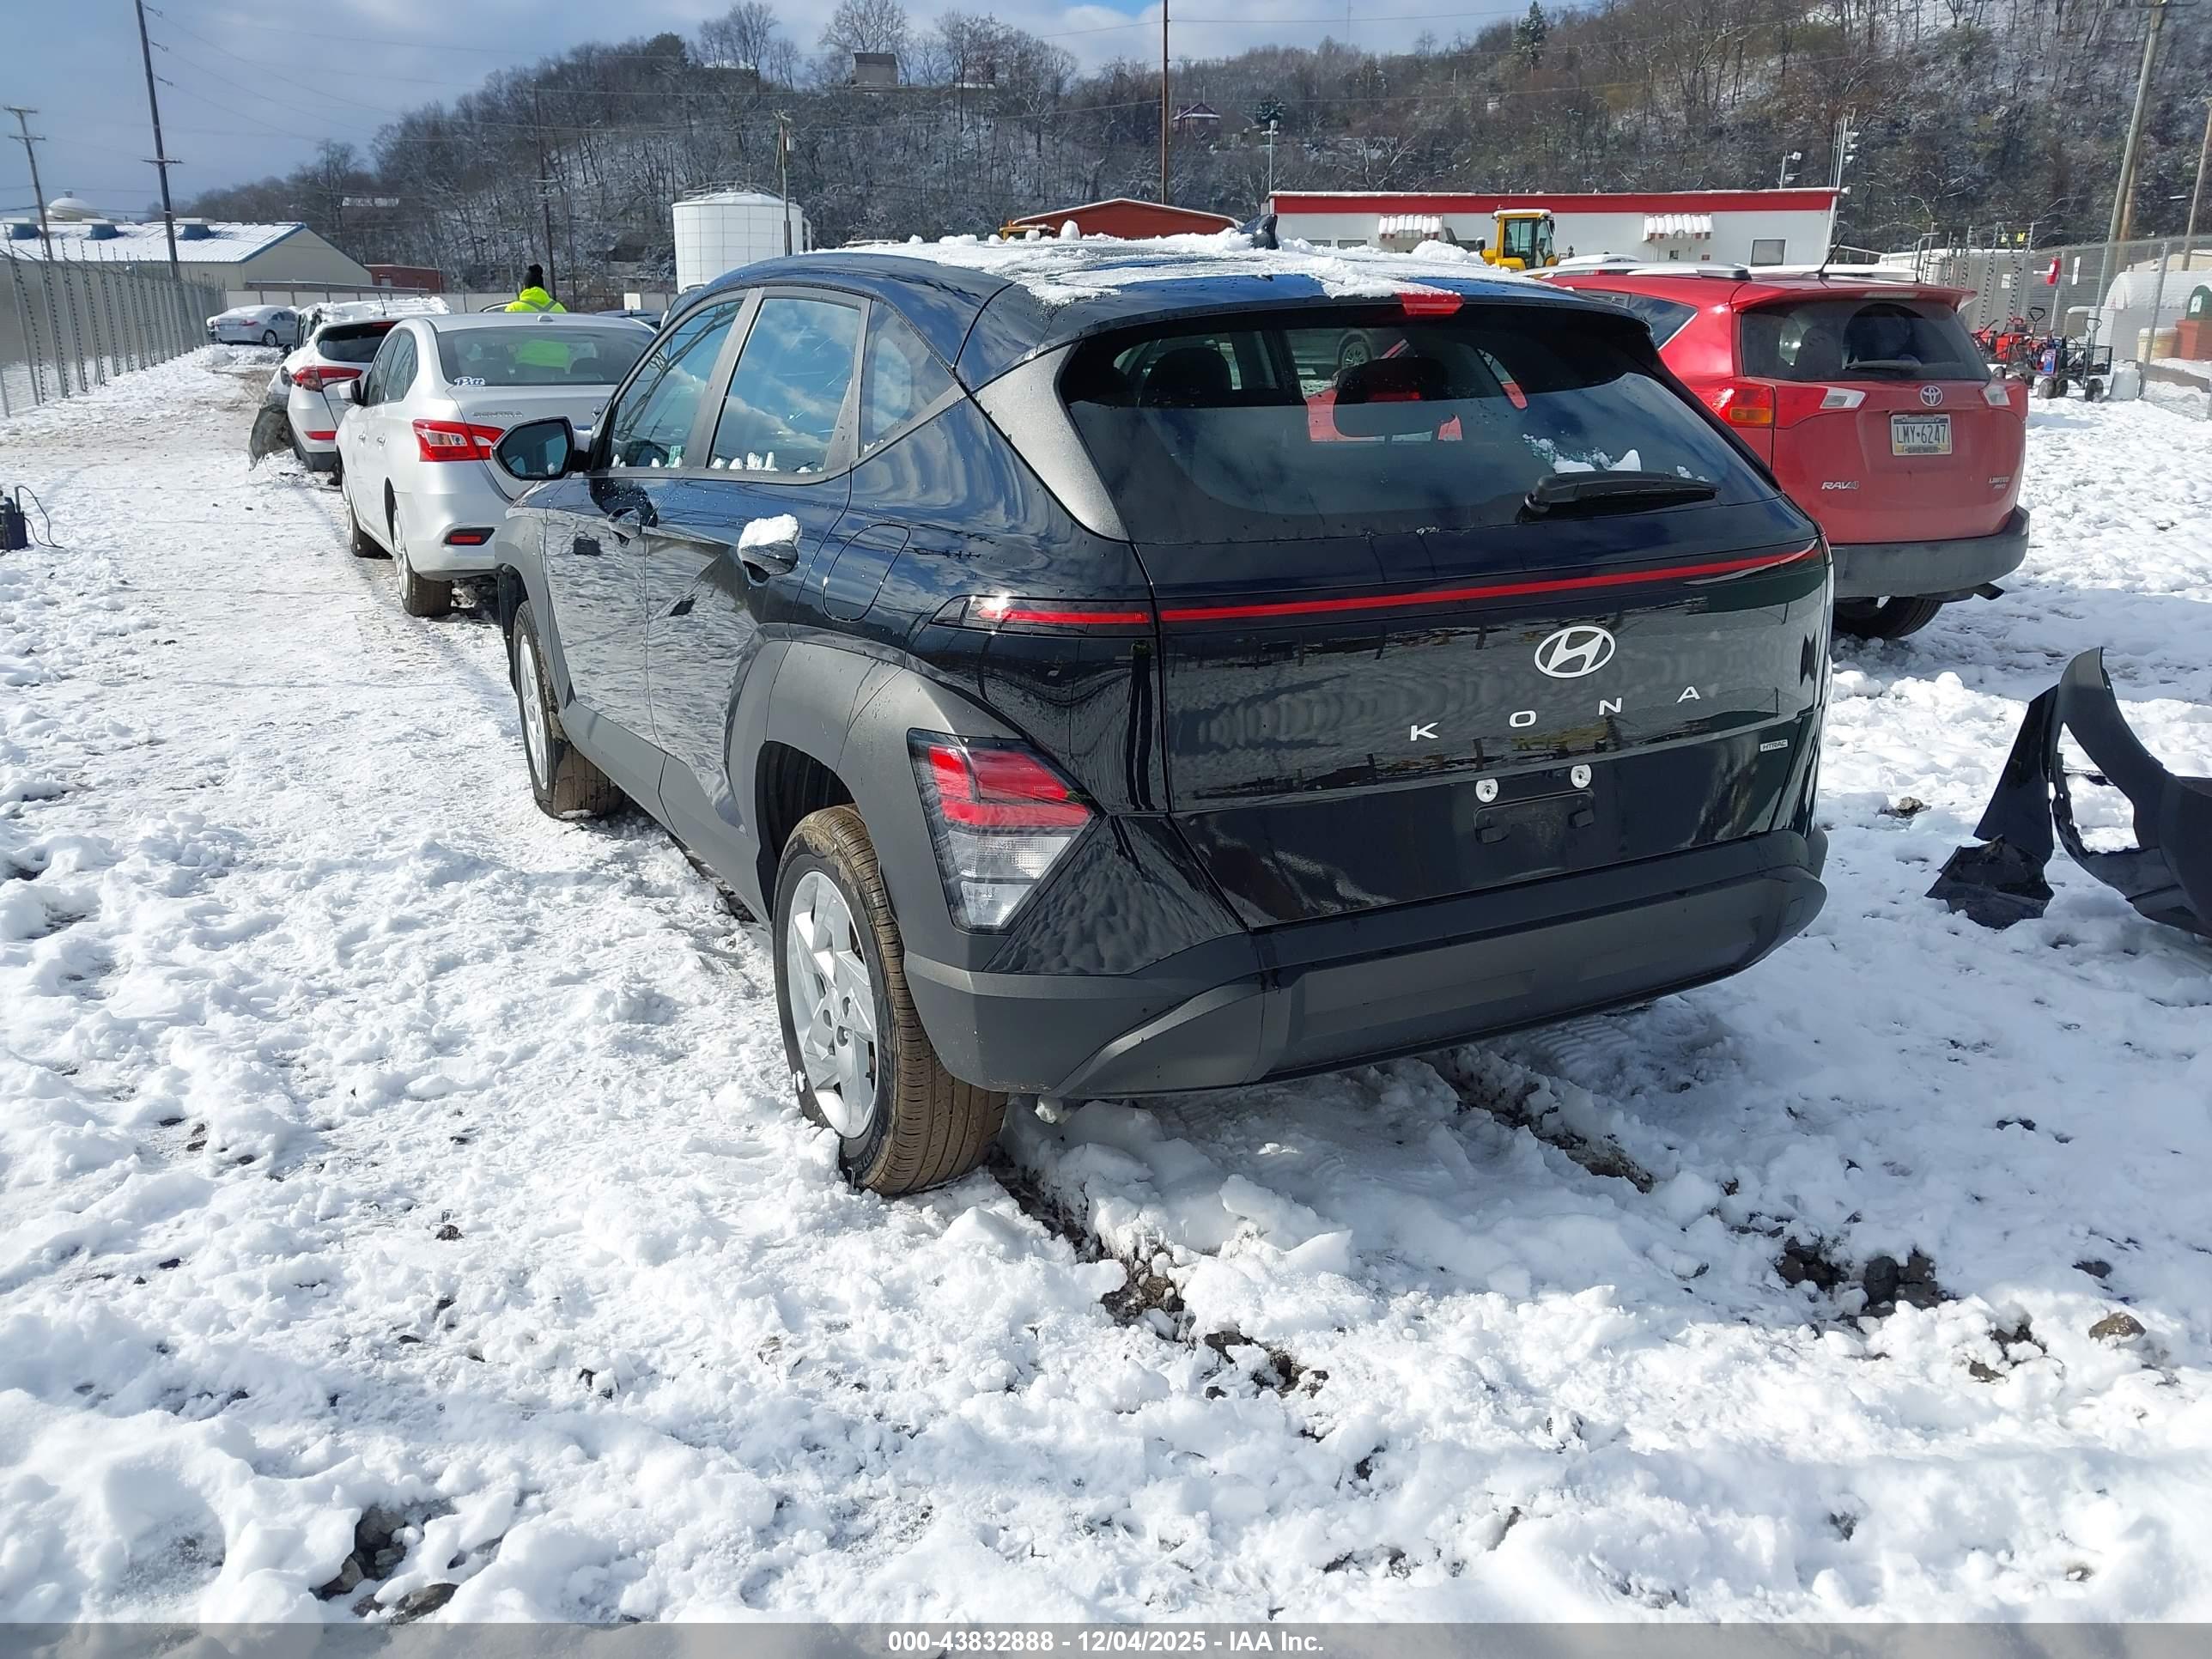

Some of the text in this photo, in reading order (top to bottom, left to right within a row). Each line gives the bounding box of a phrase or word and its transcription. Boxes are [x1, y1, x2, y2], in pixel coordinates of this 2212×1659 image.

[453, 376, 485, 386] Pitt
[1821, 481, 1859, 489] RAV4
[1761, 739, 1788, 750] HTRAC
